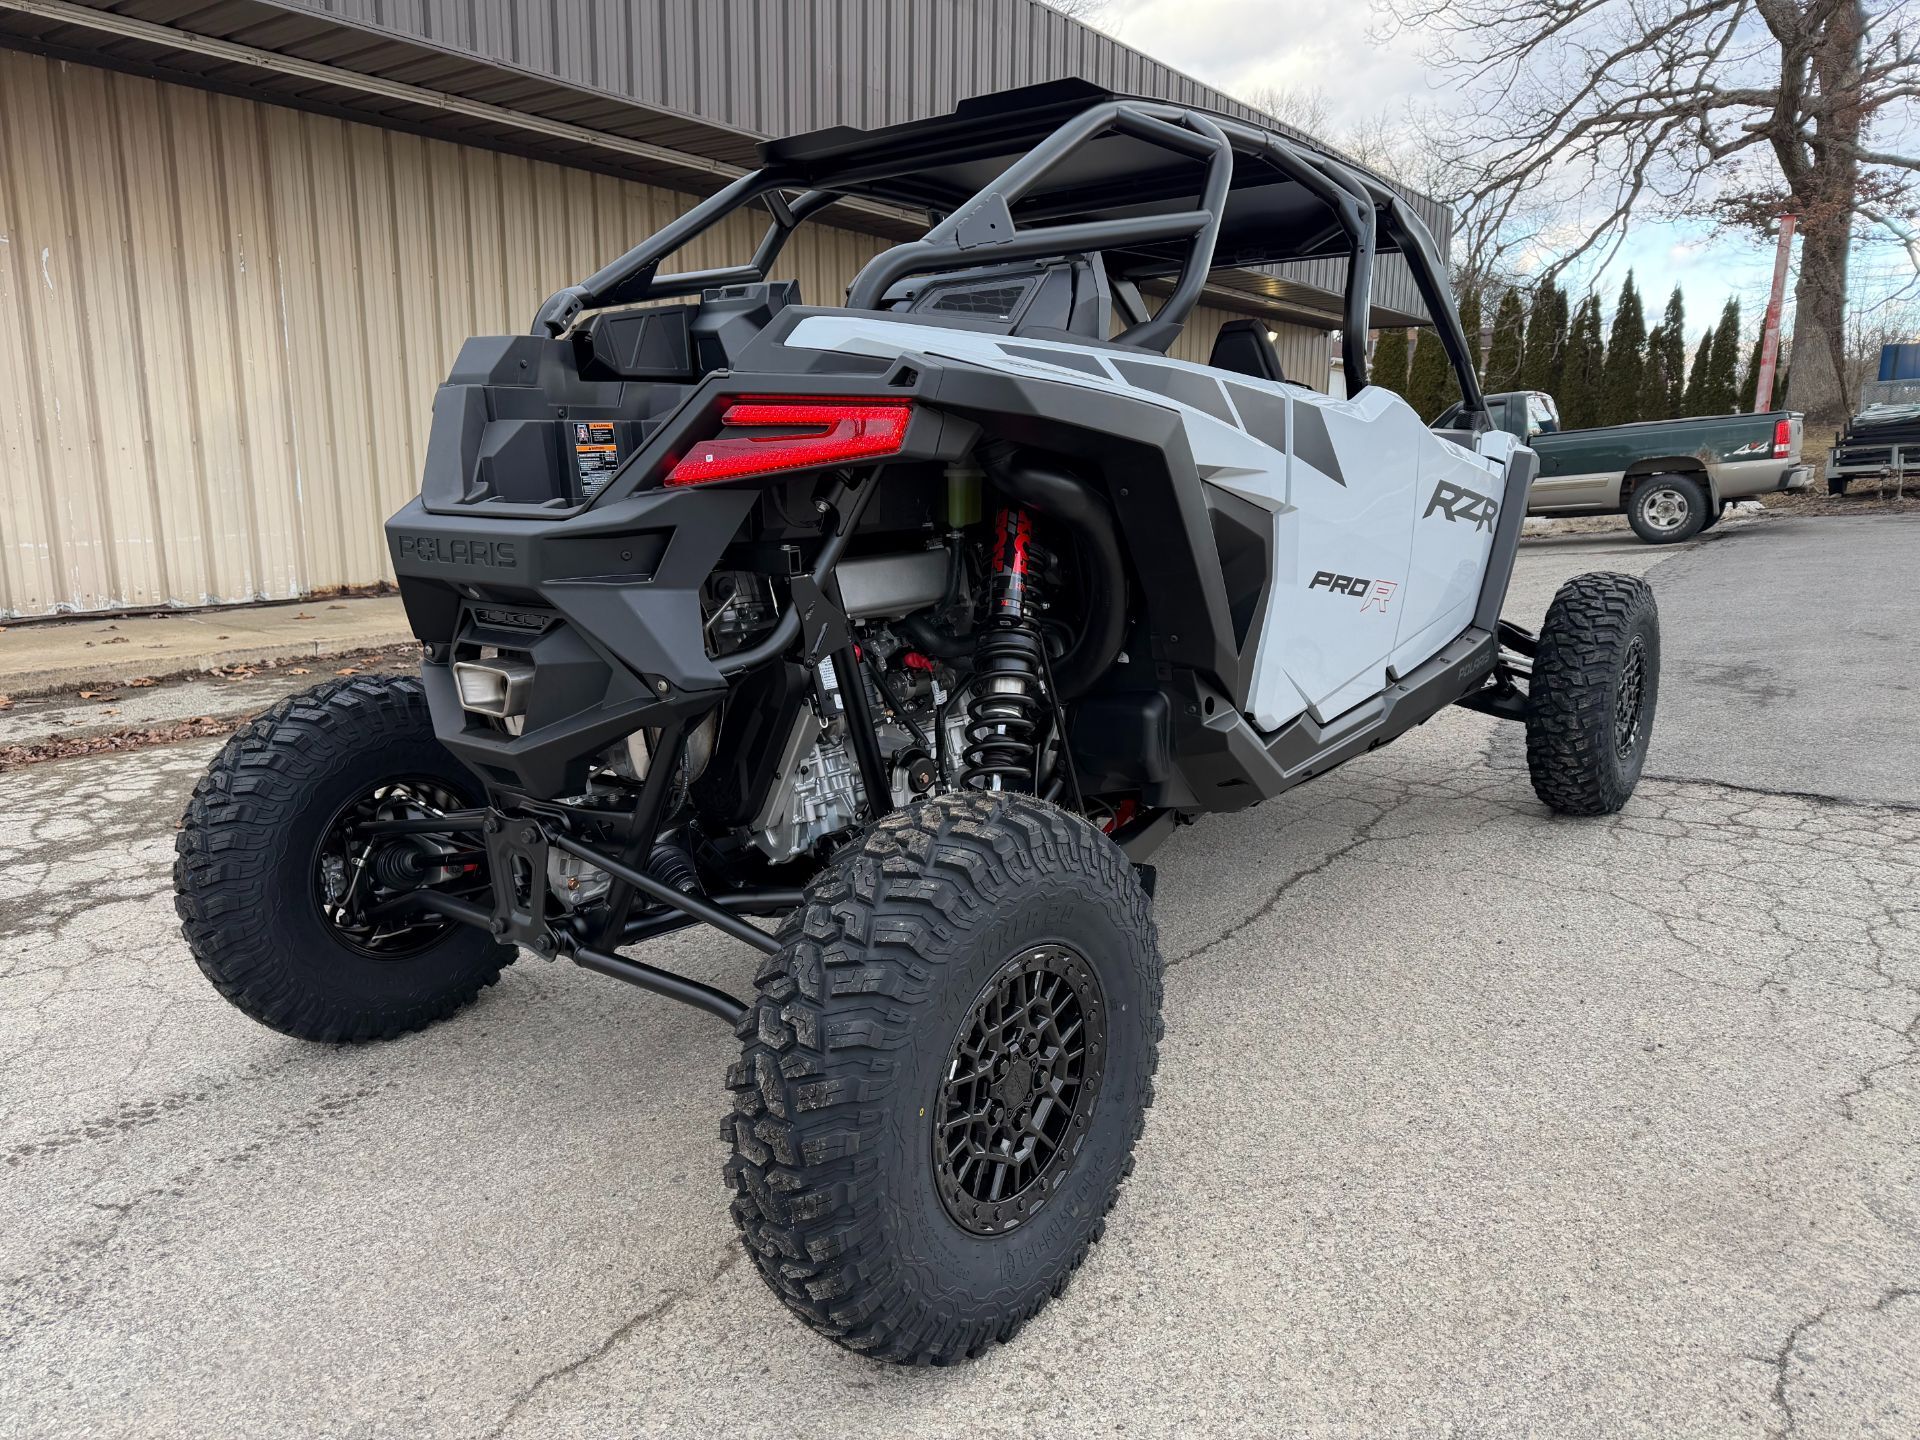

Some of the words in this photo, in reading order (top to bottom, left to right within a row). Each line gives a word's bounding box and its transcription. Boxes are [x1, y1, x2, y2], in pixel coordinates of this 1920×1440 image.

[1422, 479, 1499, 534] RZR
[399, 535, 517, 568] POLARIS
[1308, 570, 1371, 597] PRO
[1360, 579, 1398, 613] R
